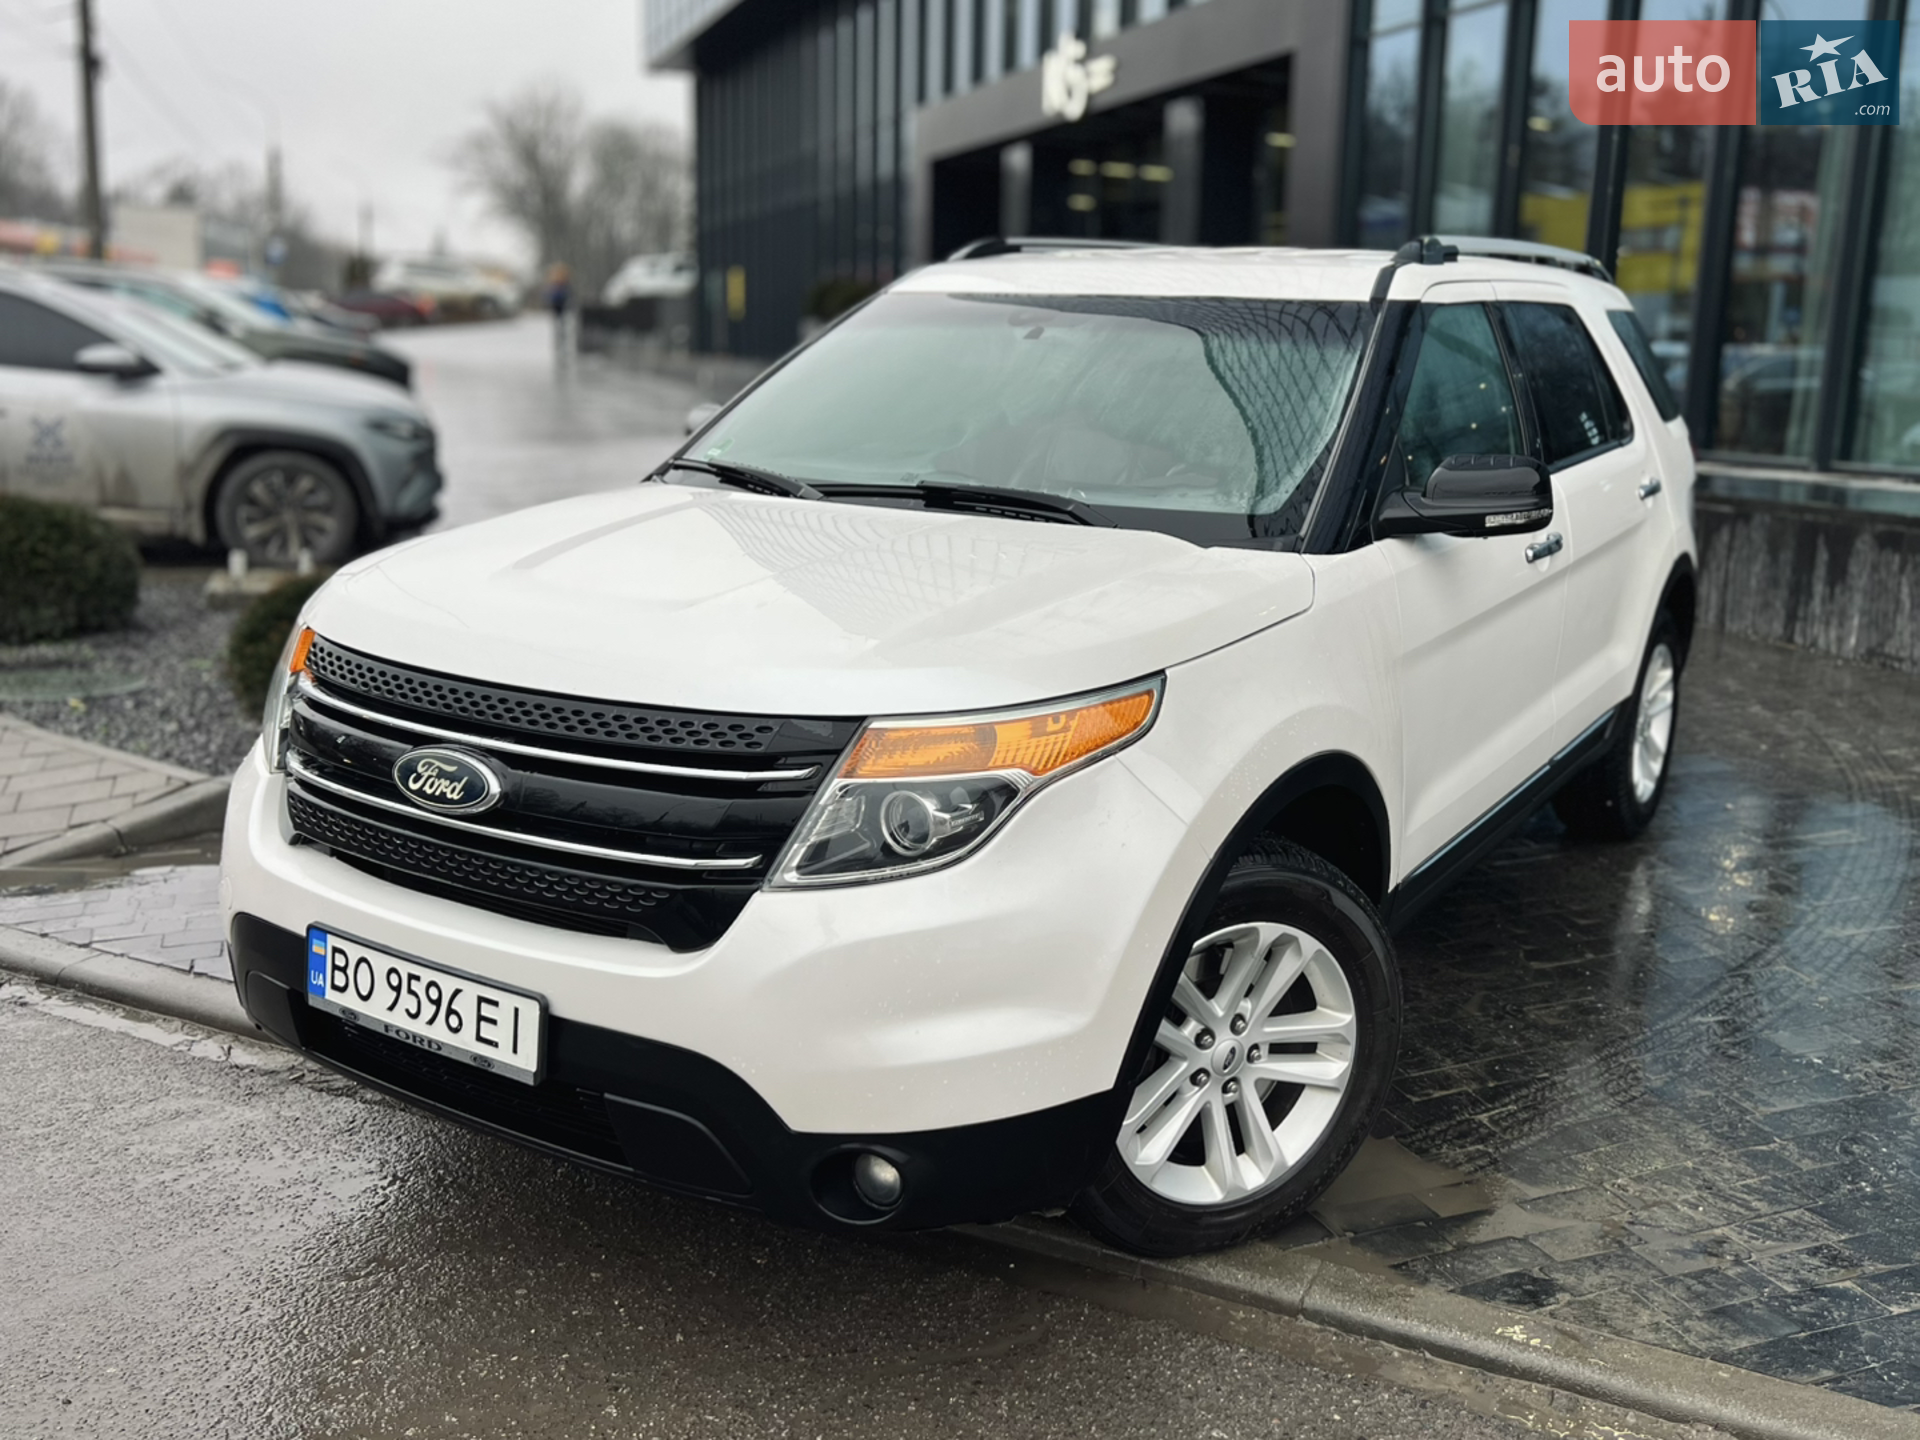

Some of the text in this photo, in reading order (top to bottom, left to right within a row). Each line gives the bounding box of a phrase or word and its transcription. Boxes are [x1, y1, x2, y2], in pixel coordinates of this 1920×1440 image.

[408, 758, 469, 800] Ford
[311, 970, 325, 988] UA
[330, 945, 520, 1055] BO 9596 EI
[383, 1024, 443, 1051] FORD
